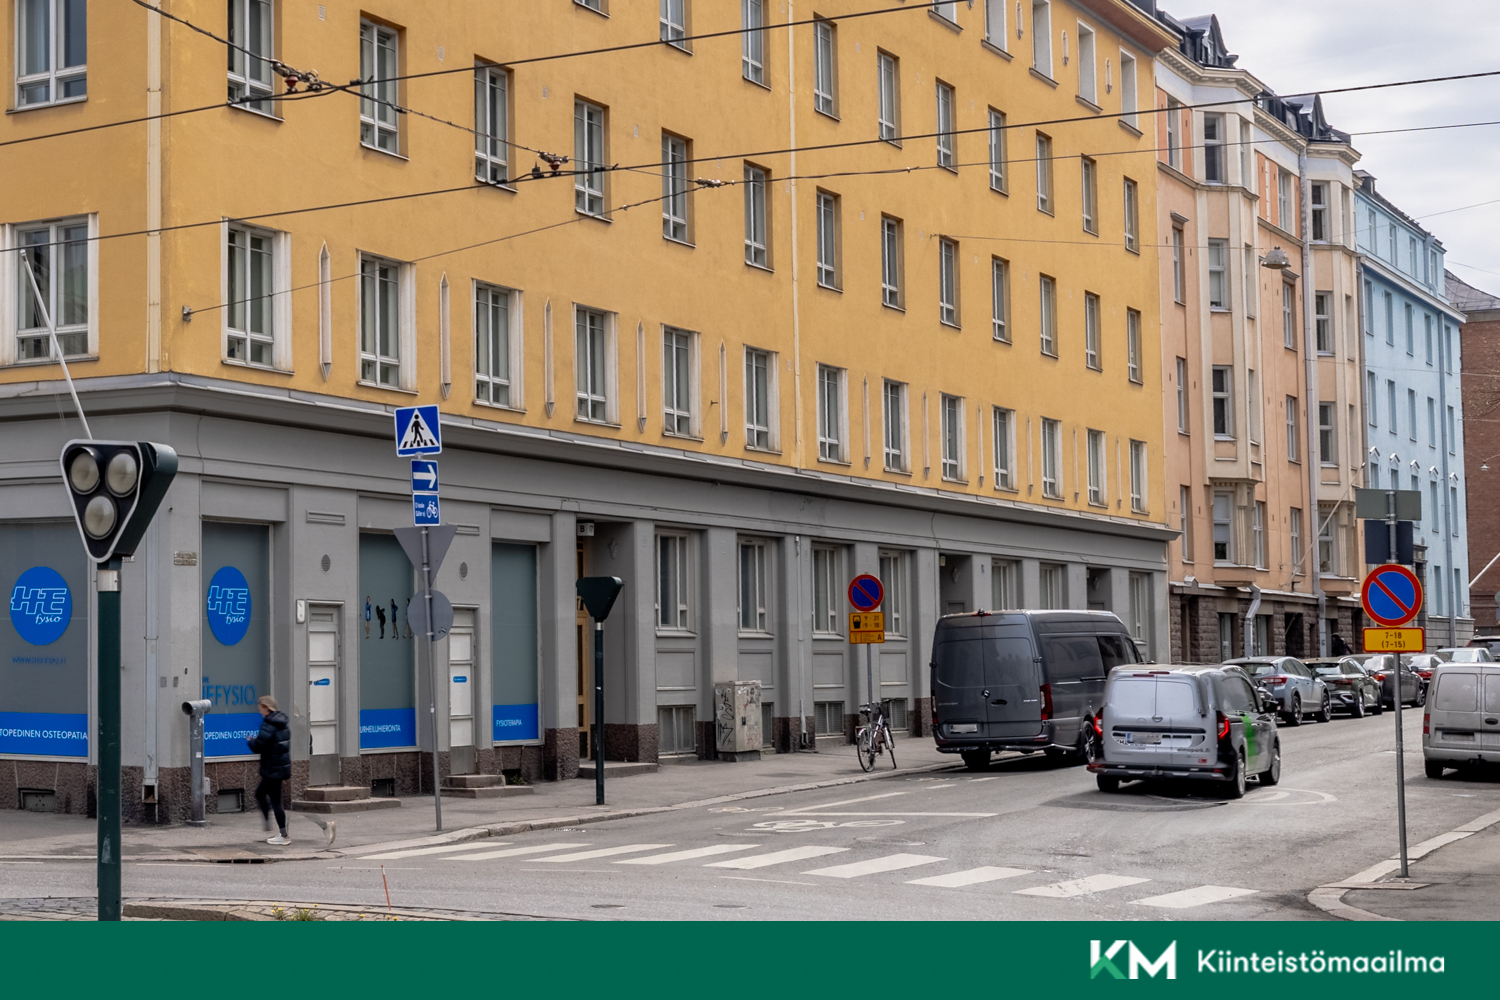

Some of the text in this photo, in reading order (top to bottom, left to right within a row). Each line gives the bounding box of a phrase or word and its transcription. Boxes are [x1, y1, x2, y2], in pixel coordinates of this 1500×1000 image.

[35, 613, 63, 625] fysio
[225, 613, 246, 625] fysio
[1381, 640, 1406, 649] (7-15)
[496, 719, 523, 727] FYSIOTERAPIA
[42, 729, 88, 740] OSTEOPATIA
